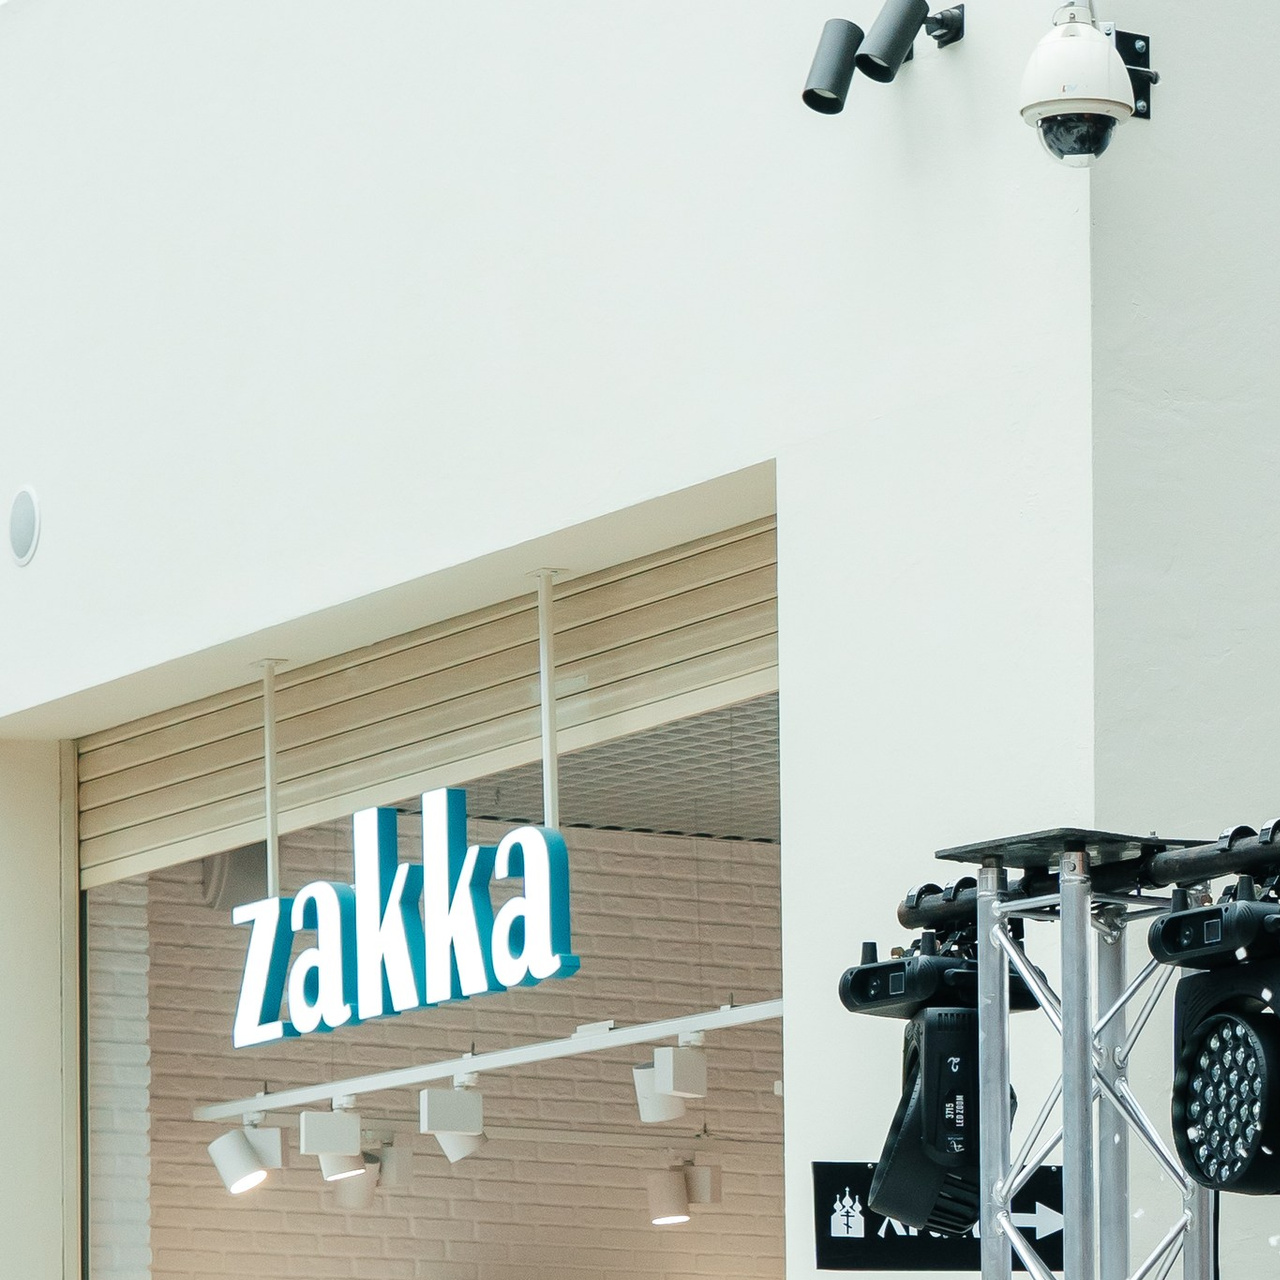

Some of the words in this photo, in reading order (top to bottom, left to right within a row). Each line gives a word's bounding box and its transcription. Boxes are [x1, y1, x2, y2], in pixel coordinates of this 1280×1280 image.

[232, 787, 580, 1049] zakka
[945, 1103, 954, 1119] 3715
[956, 1094, 964, 1114] ZOOM
[956, 1114, 964, 1127] LED
